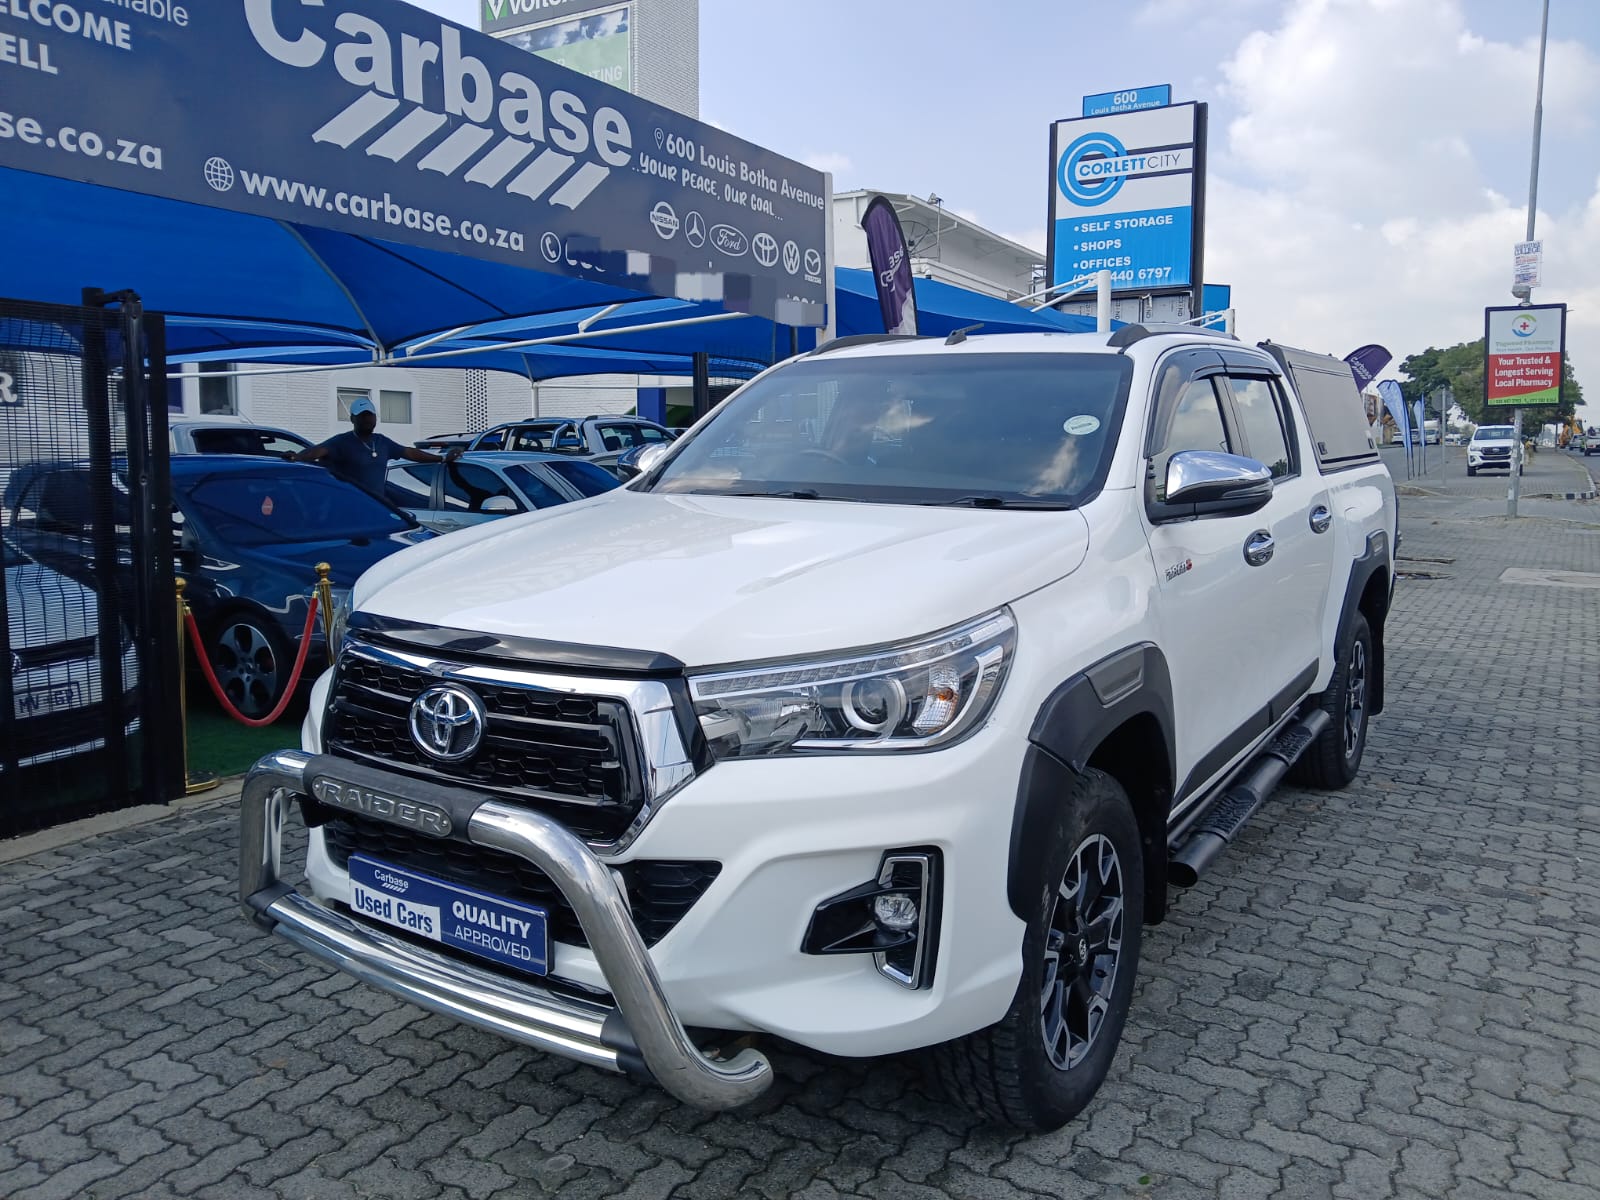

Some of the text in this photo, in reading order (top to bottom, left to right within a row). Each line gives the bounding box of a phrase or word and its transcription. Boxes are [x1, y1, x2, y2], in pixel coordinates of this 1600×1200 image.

[243, 0, 632, 167] Carbase
[1091, 100, 1160, 115] Louis Botha Avenue
[1113, 91, 1137, 105] 600
[666, 133, 825, 210] 600 Louis Botha Avenue
[724, 183, 748, 206] OUR
[240, 169, 525, 252] www.carbase.co.za
[651, 212, 679, 227] NISSAN
[1081, 214, 1173, 233] SELF STORAGE
[717, 228, 742, 250] Ford
[1080, 239, 1122, 252] SHOPS
[1080, 256, 1131, 270] OFFICES
[1138, 266, 1172, 280] 6797
[1497, 355, 1551, 366] Your Trusted &
[1494, 367, 1554, 377] Longest Serving
[1494, 378, 1553, 388] Local Pharmacy
[321, 779, 442, 832] RAIDER
[374, 868, 409, 889] Carbase
[355, 887, 433, 934] Used Cars
[452, 900, 531, 939] QUALITY
[453, 924, 532, 962] APPROVED
